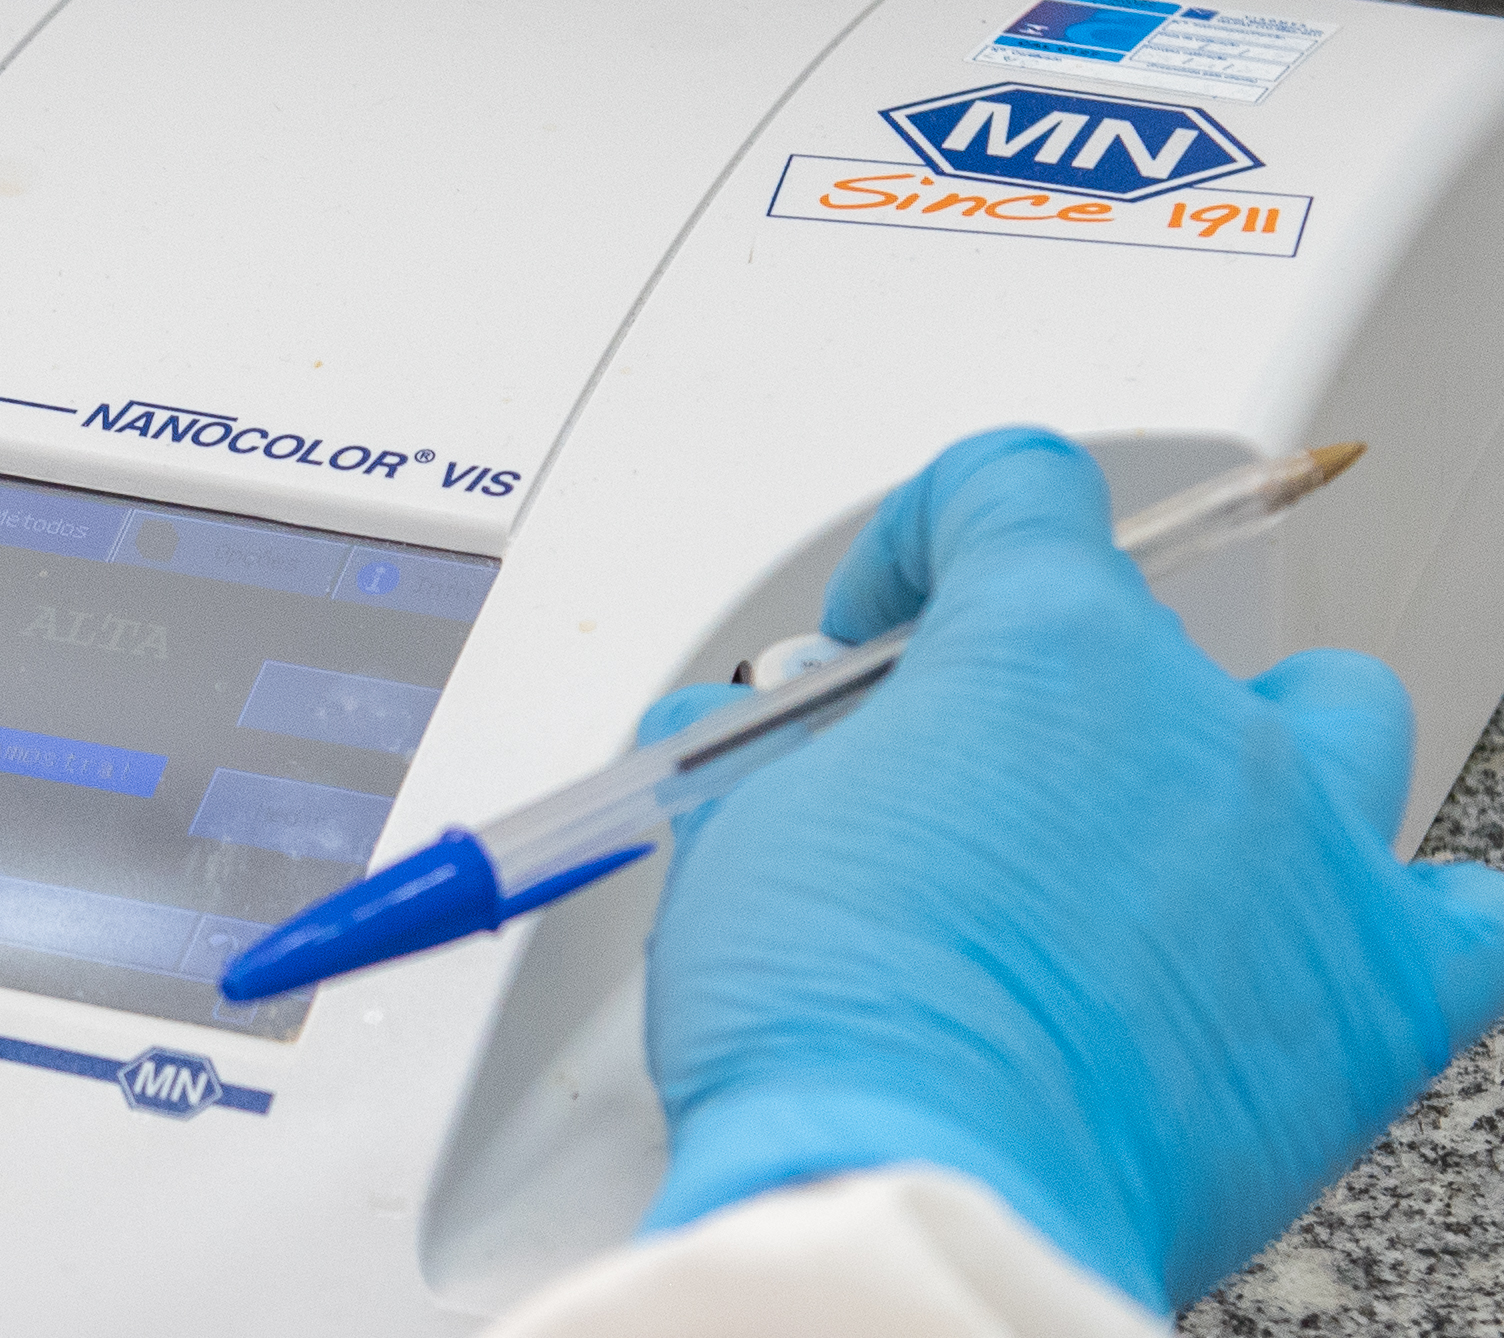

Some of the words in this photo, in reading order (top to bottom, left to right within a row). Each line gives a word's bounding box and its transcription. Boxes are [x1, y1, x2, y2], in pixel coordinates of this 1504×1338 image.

[941, 99, 1199, 180] MN
[819, 172, 1115, 224] Since
[1167, 201, 1280, 238] 1911
[441, 461, 522, 497] VIS
[18, 603, 170, 660] ALTA
[133, 1059, 211, 1106] MN
